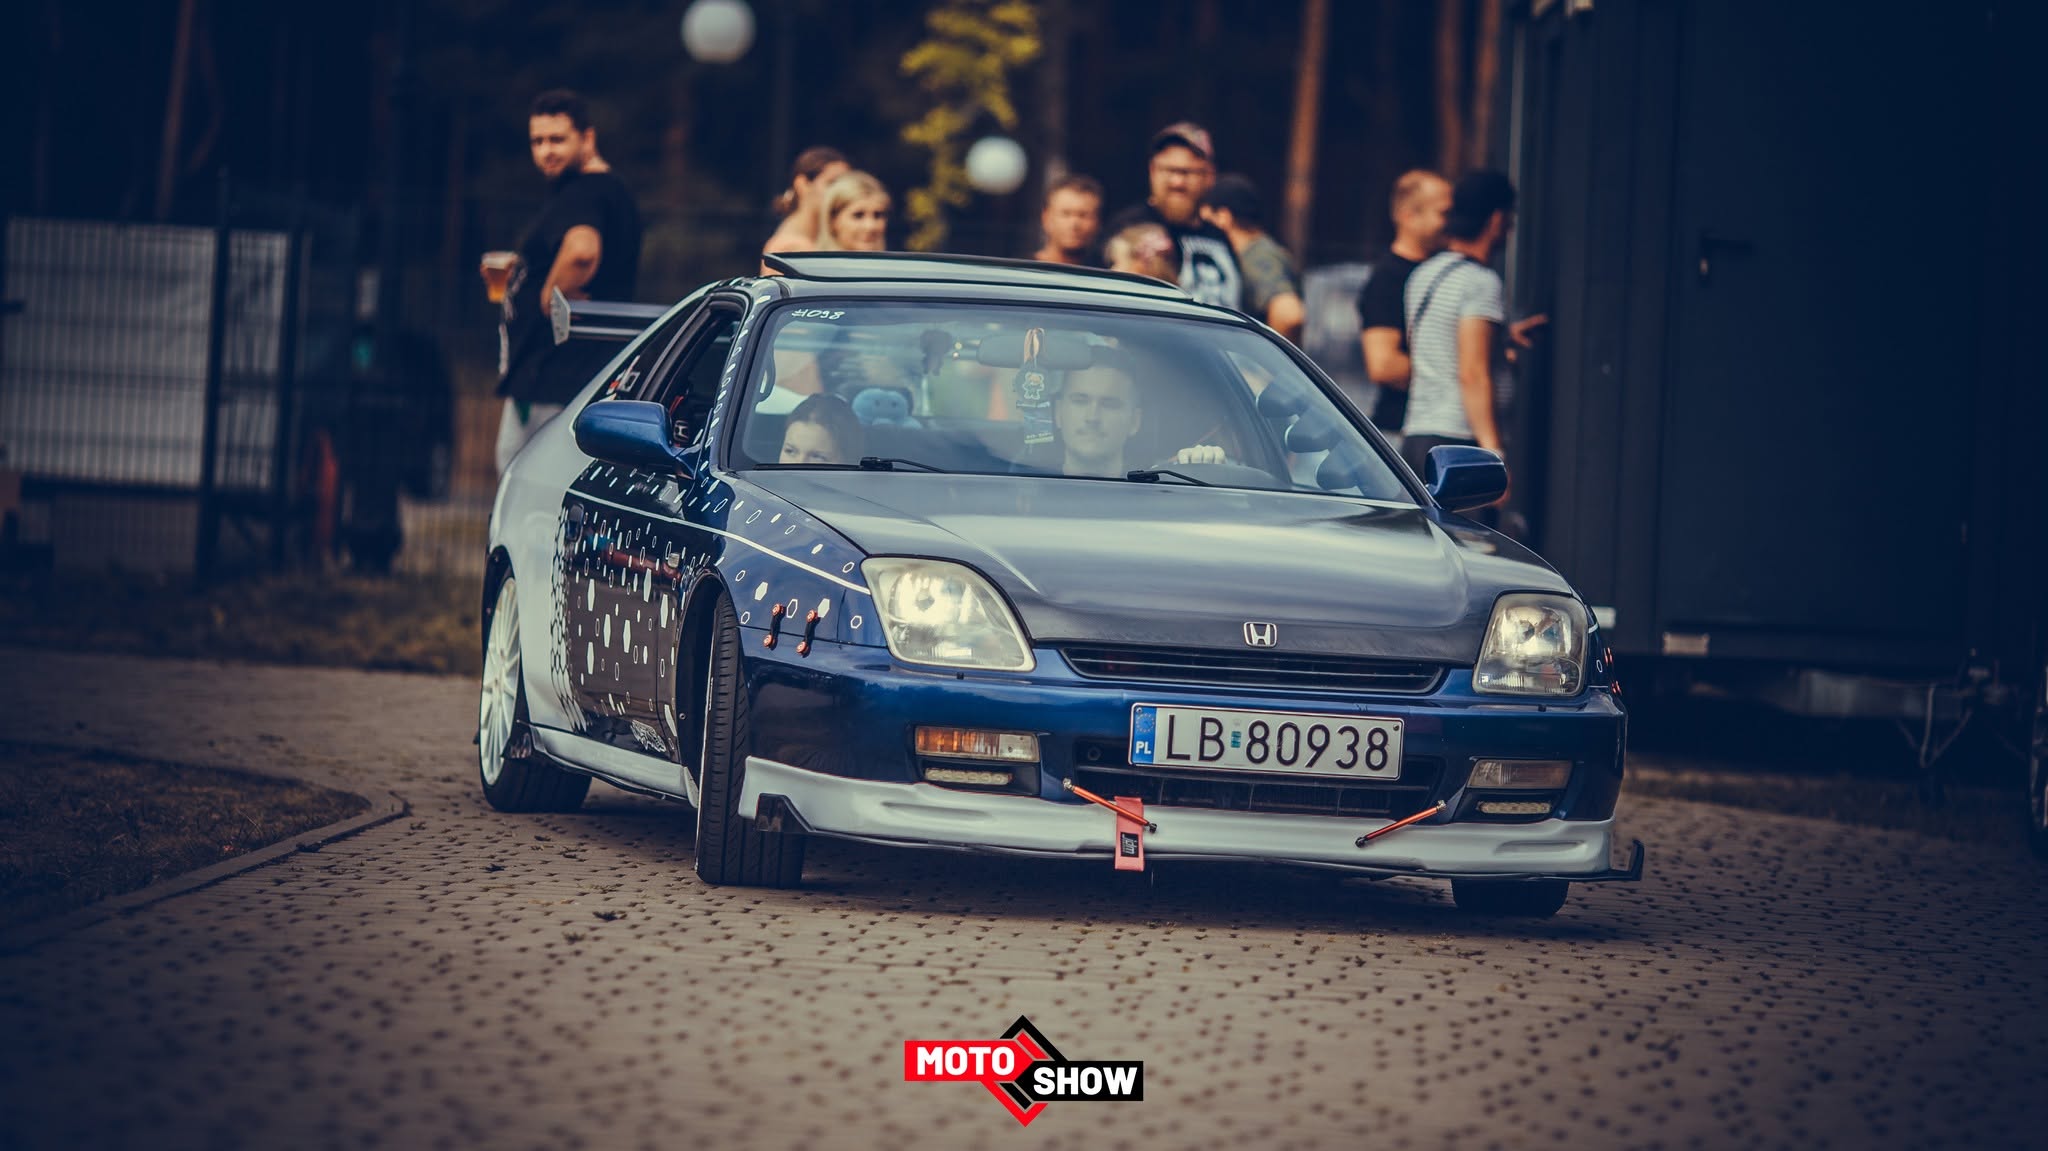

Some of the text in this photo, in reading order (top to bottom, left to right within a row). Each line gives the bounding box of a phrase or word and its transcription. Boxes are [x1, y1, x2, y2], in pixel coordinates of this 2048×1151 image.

[1136, 740, 1151, 755] PL
[1166, 714, 1389, 771] LB 80938
